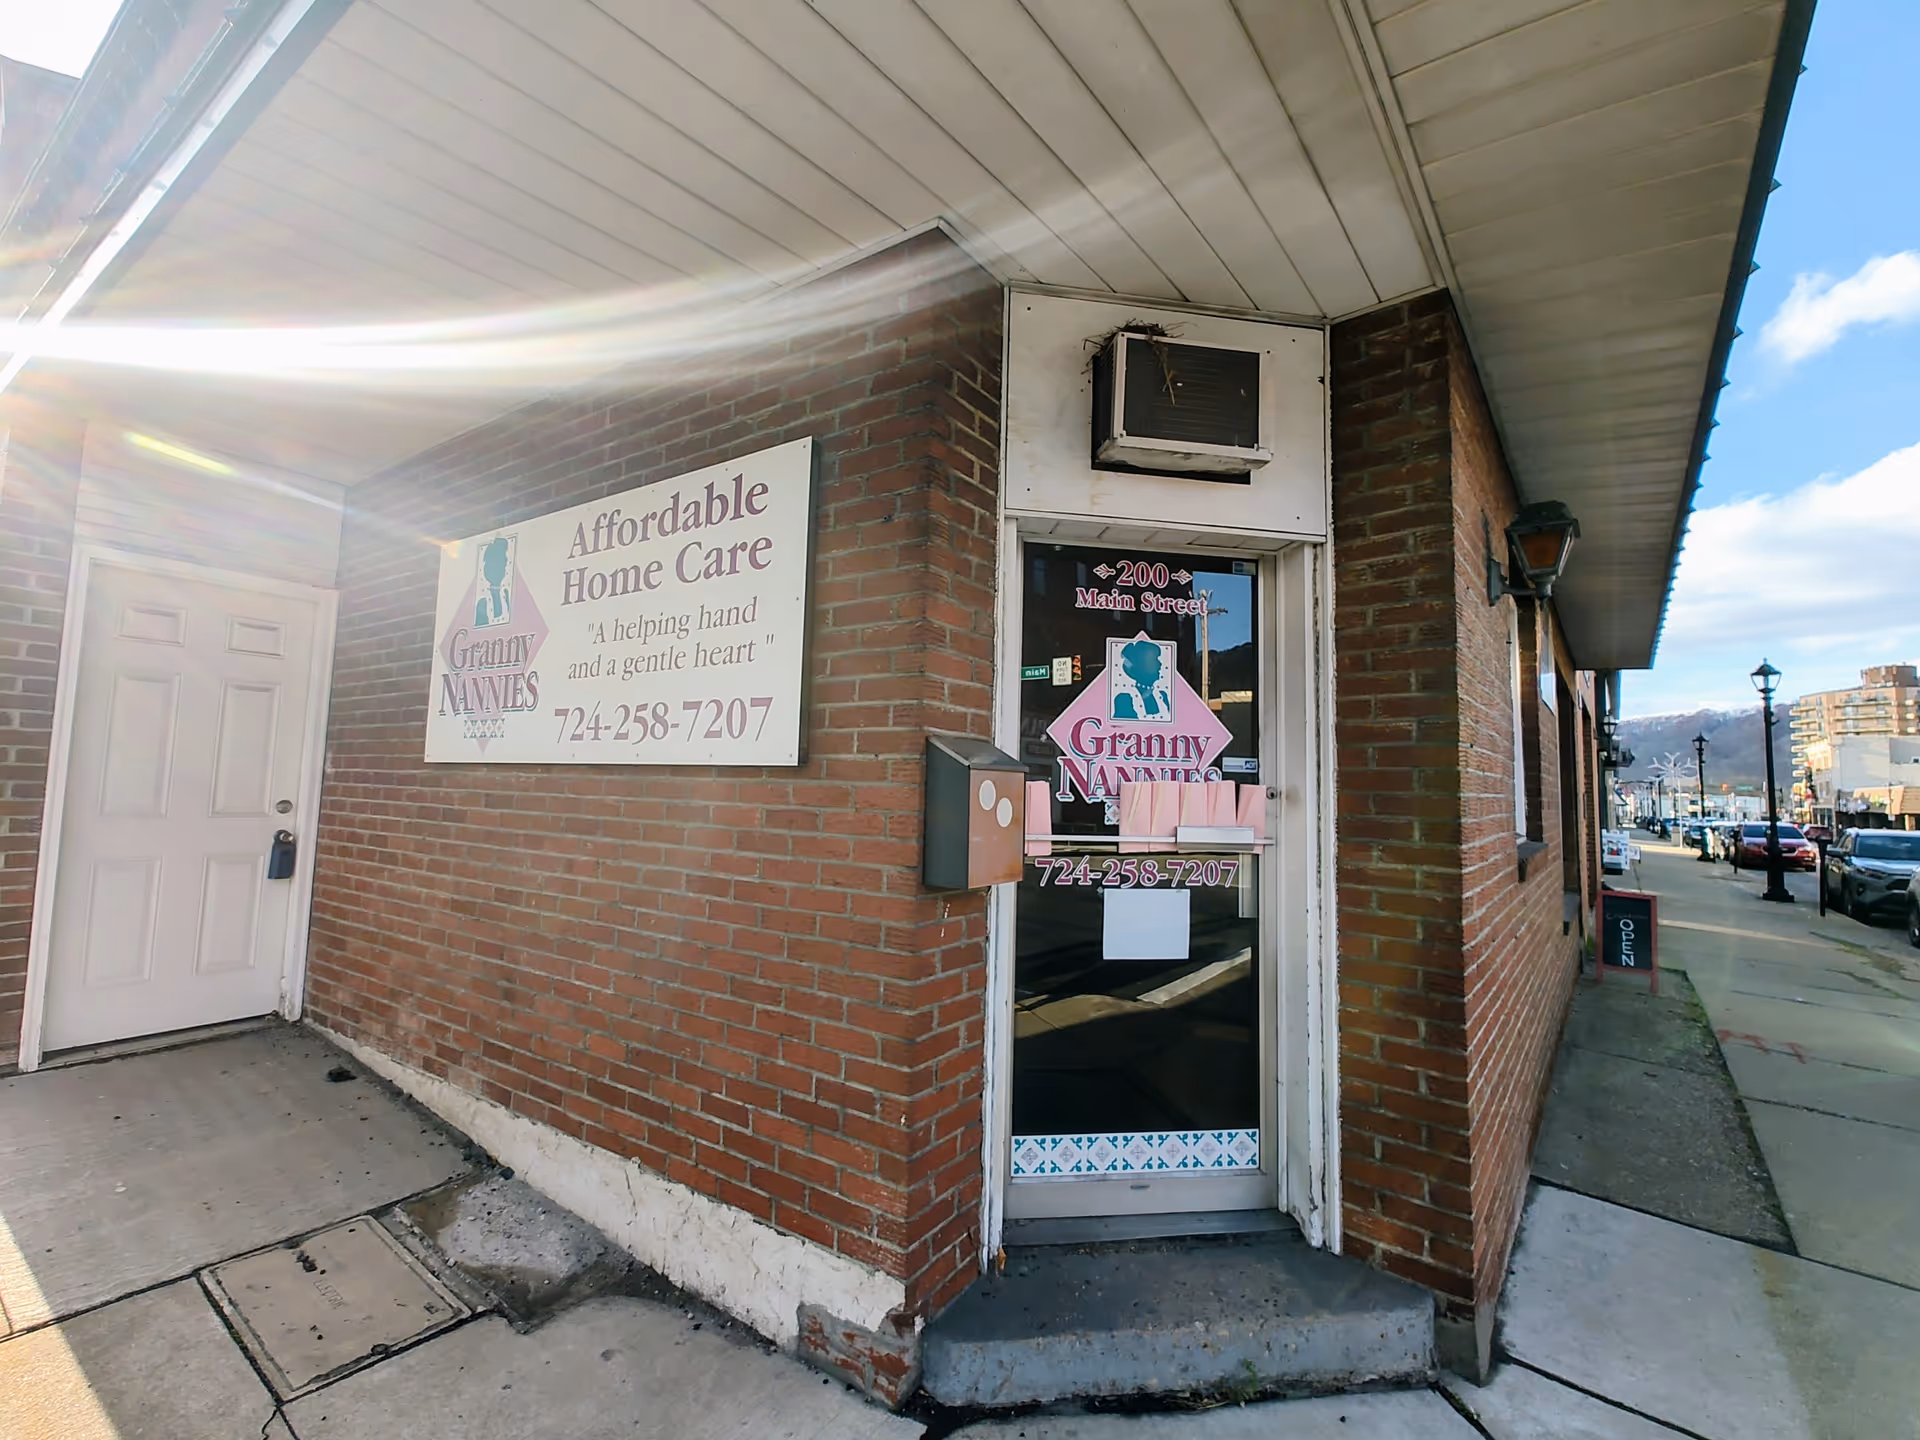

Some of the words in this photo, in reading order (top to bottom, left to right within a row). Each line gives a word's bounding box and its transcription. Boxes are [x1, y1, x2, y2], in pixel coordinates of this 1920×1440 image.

[567, 473, 769, 560] Affordable
[560, 558, 664, 606] Home
[675, 536, 773, 584] Care
[1116, 560, 1169, 588] 200
[588, 622, 606, 645] "A
[612, 610, 690, 647] helping
[697, 596, 757, 631] hand
[1075, 587, 1136, 612] Main
[1141, 591, 1208, 615] Street
[449, 628, 536, 674] Granny
[568, 654, 600, 680] and
[606, 660, 616, 677] a
[621, 646, 686, 681] gentle
[693, 638, 756, 669] heart
[438, 670, 540, 717] NANNIES
[554, 696, 773, 745] 724-258-7207
[1068, 716, 1212, 769] Granny
[1035, 855, 1239, 888] 724-258-7207
[1620, 919, 1635, 967] OPEN
